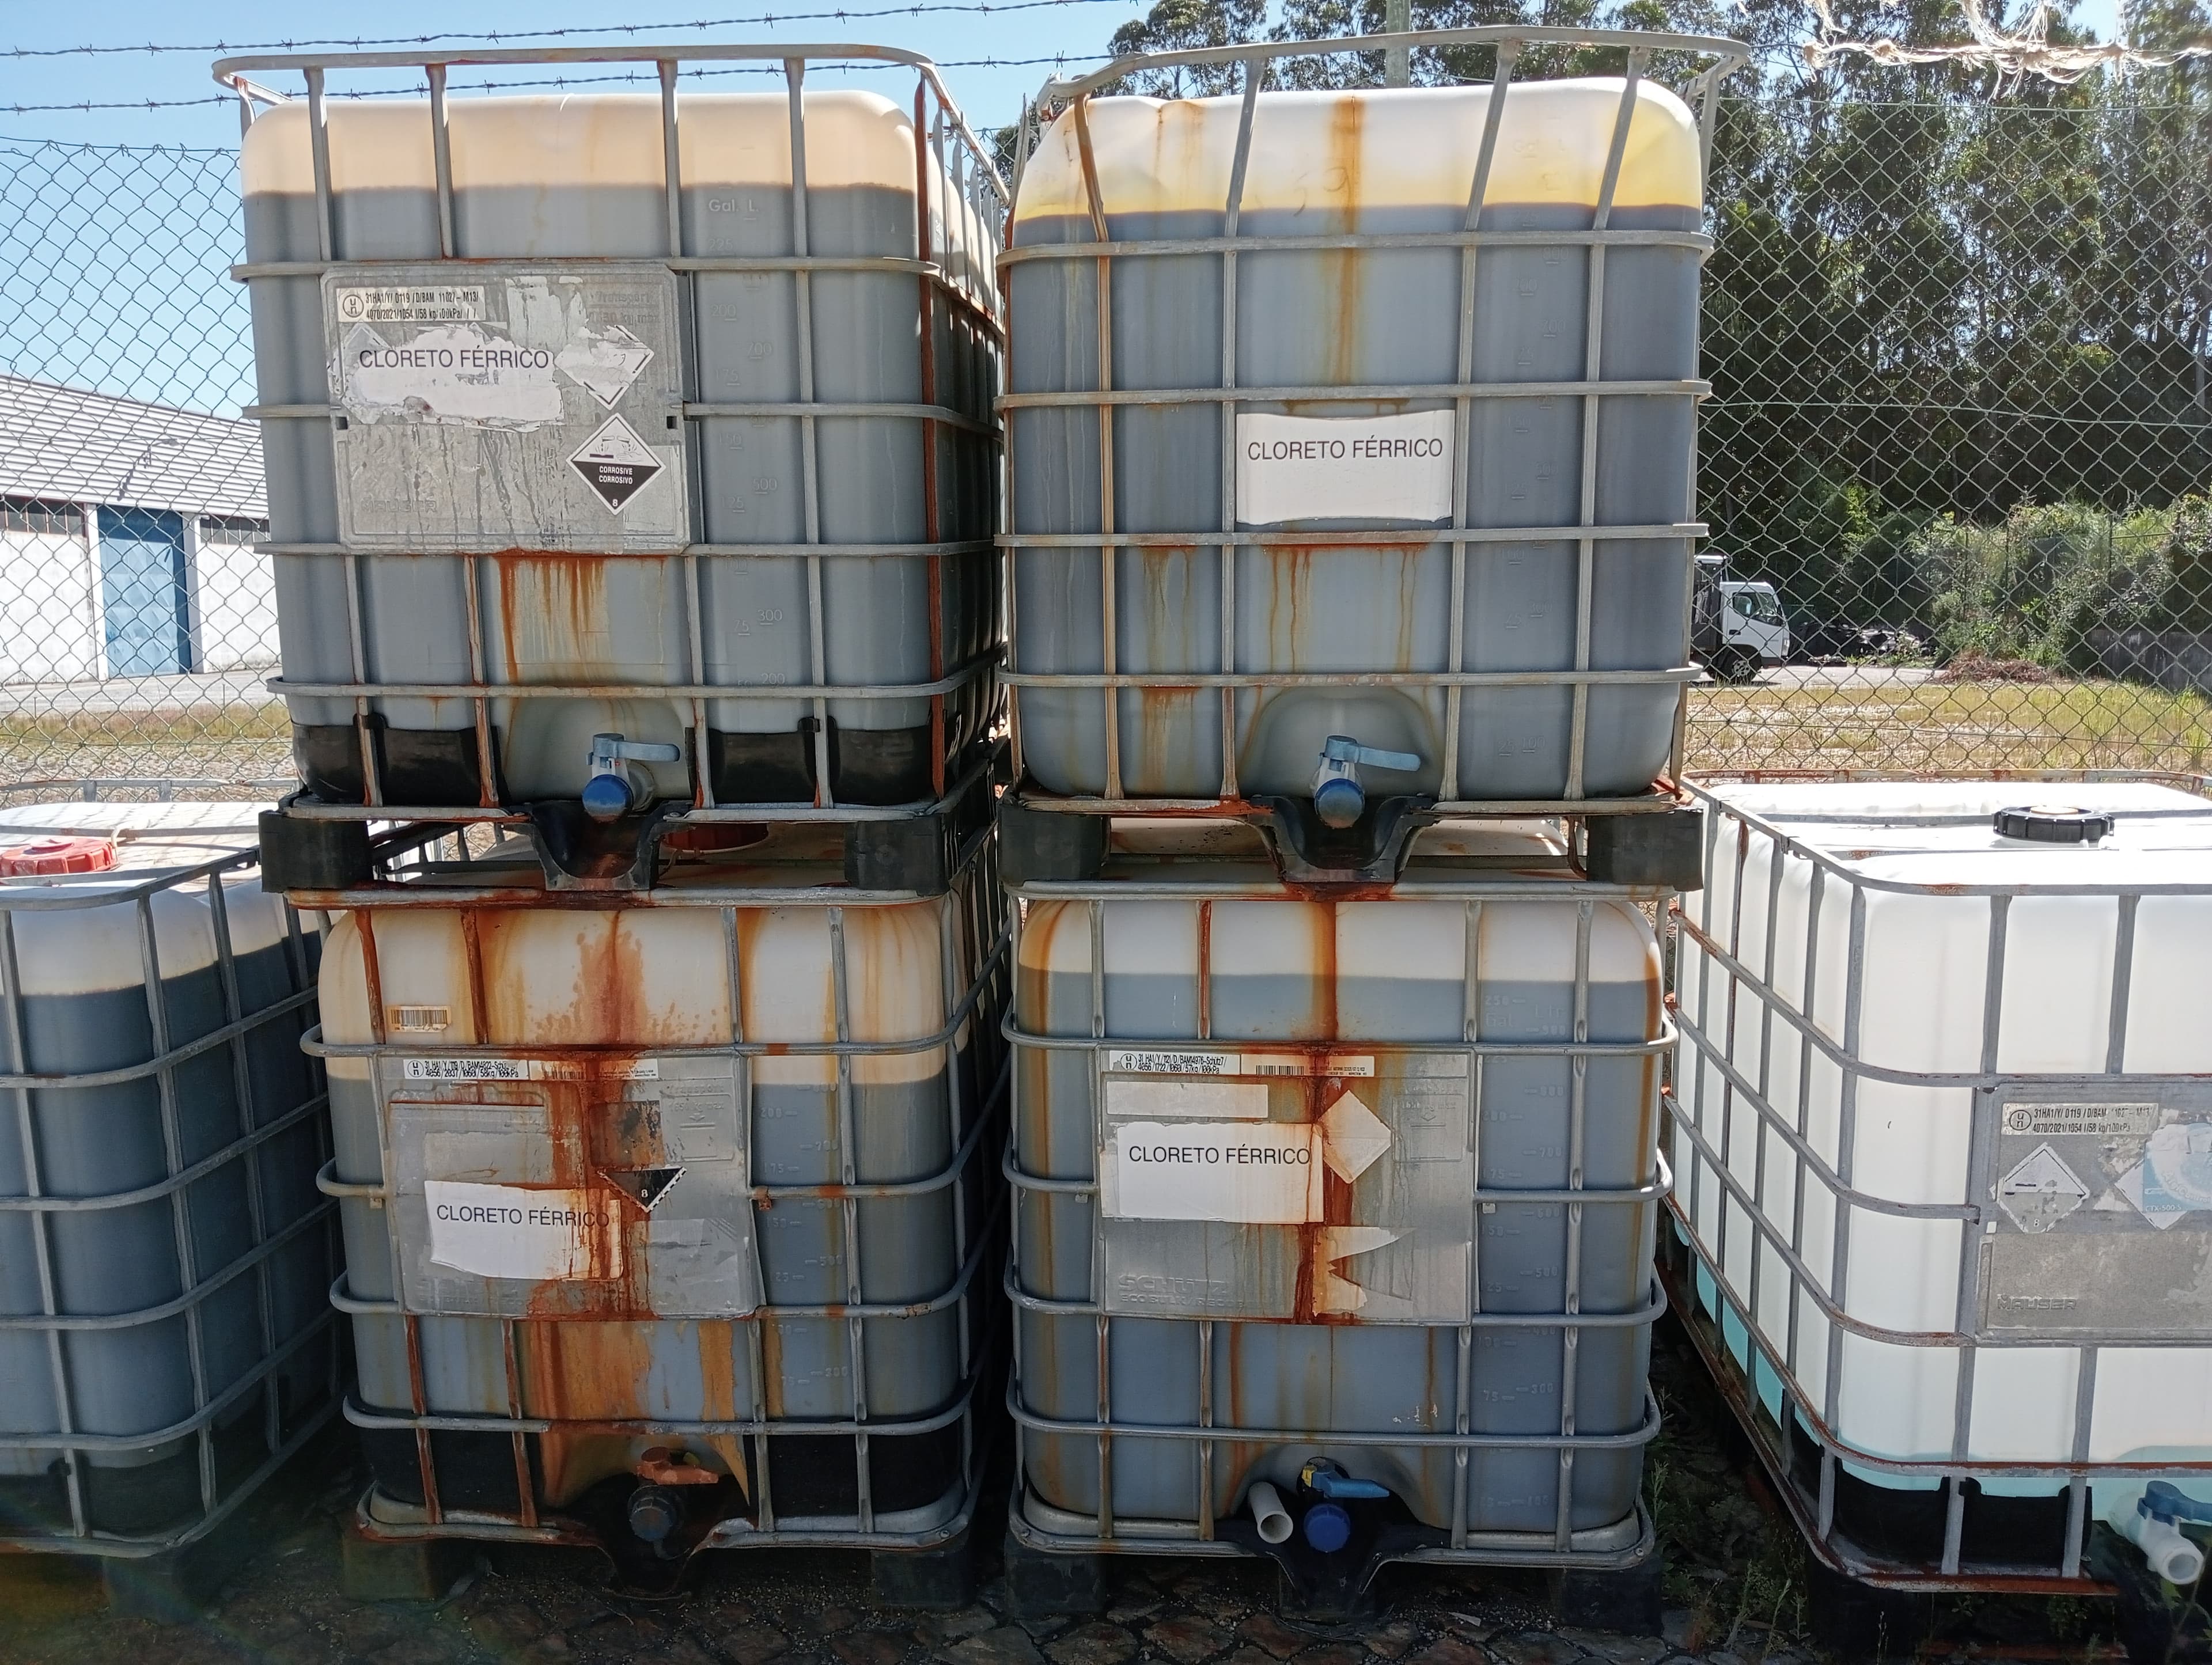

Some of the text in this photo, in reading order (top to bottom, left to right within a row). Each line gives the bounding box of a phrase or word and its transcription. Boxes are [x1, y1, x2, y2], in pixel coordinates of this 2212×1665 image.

[710, 304, 736, 317] 200
[747, 342, 772, 356] 700
[359, 346, 550, 369] CLORETO FÉRRICO
[714, 369, 738, 382] 175
[1248, 434, 1443, 460] CLORETO FÉRRICO
[600, 465, 632, 475] CORROSIVE
[599, 475, 633, 484] CORROSIVO
[752, 477, 778, 490] 500
[612, 499, 618, 507] 8
[719, 496, 744, 509] 125
[757, 609, 783, 621] 300
[733, 619, 749, 632] 75
[1130, 1143, 1310, 1165] CLORETO FÉRRICO
[641, 1189, 648, 1198] 8
[437, 1204, 609, 1228] CLORETO FÉRRICO
[2033, 1218, 2040, 1227] 8
[1997, 1294, 2077, 1310] MAUSER
[825, 1366, 849, 1378] 300
